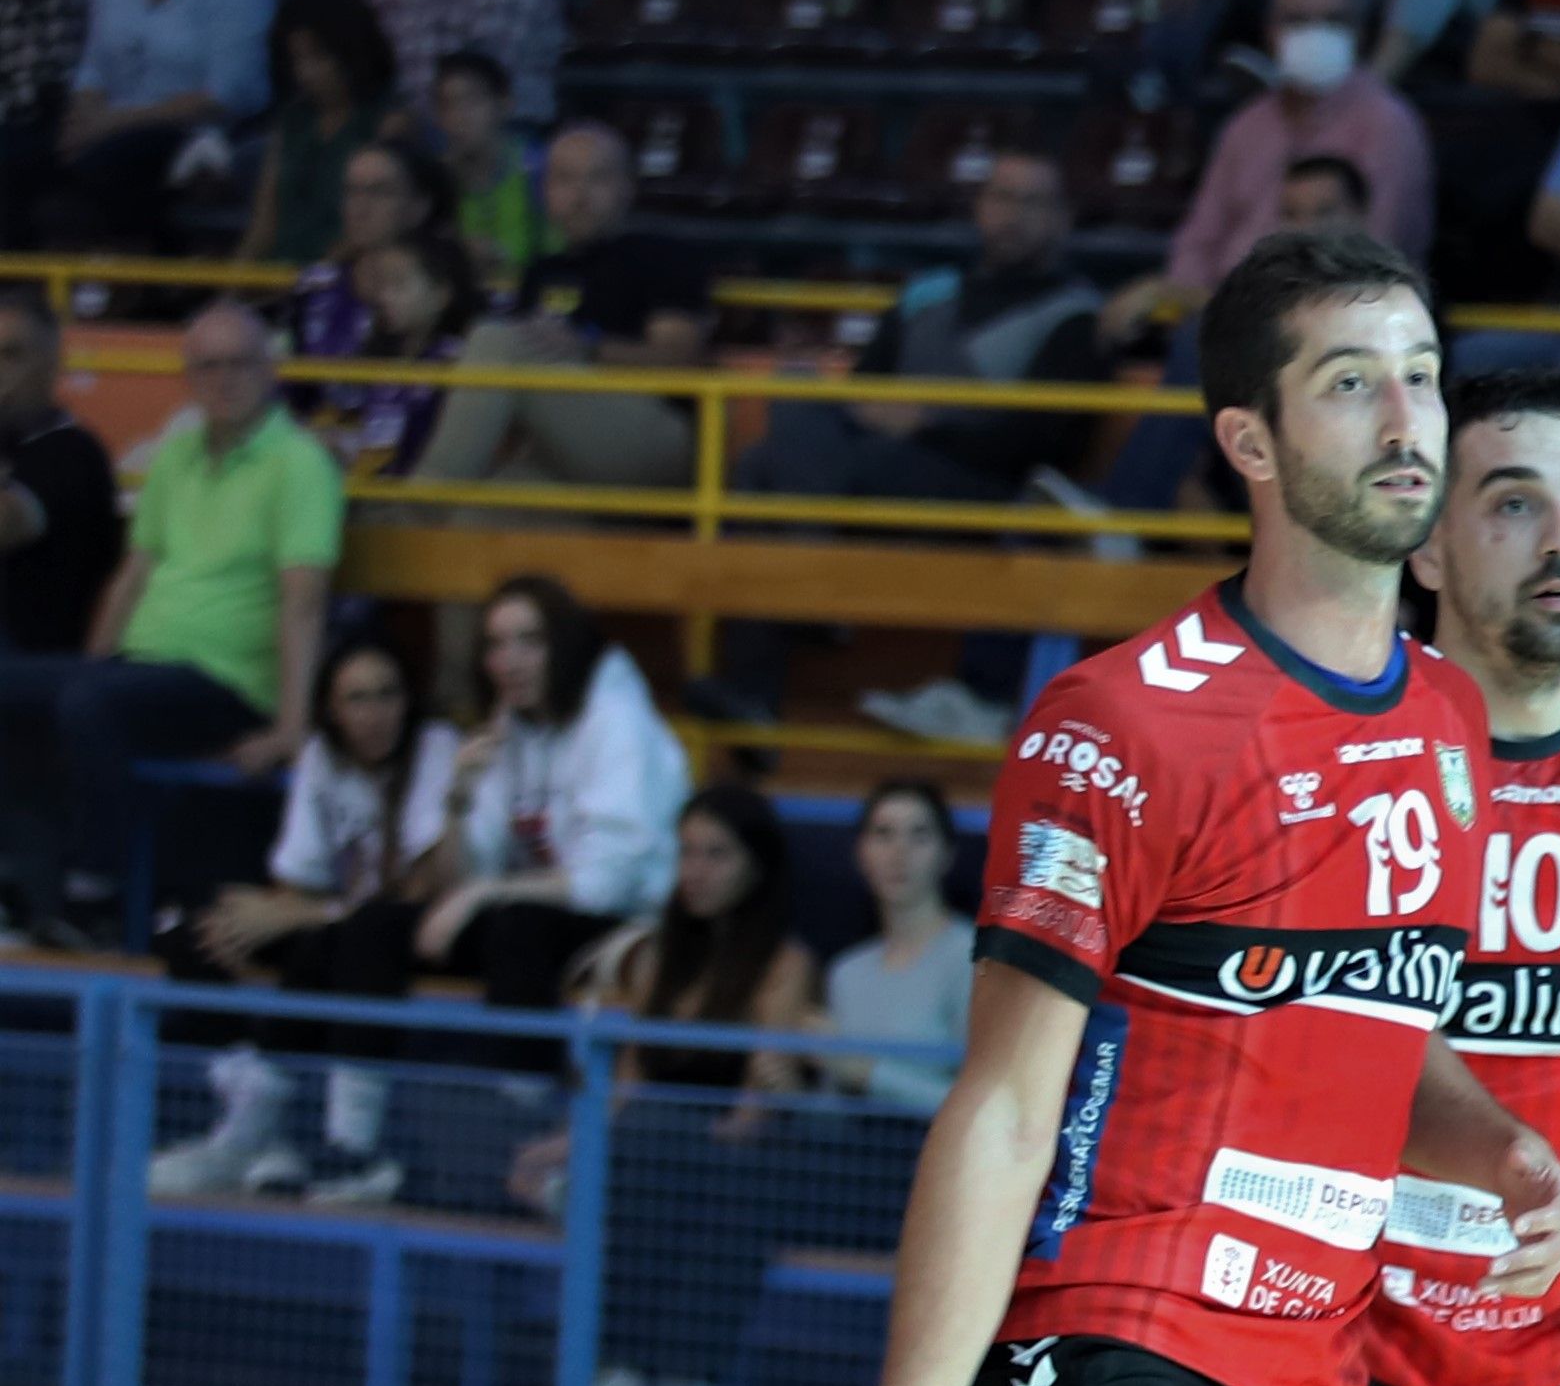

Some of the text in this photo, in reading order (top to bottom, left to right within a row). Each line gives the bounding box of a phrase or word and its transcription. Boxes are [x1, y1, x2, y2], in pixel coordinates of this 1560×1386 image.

[1346, 789, 1443, 917] 19
[1249, 1288, 1282, 1315] DE
[1260, 1259, 1337, 1306] XUNTA
